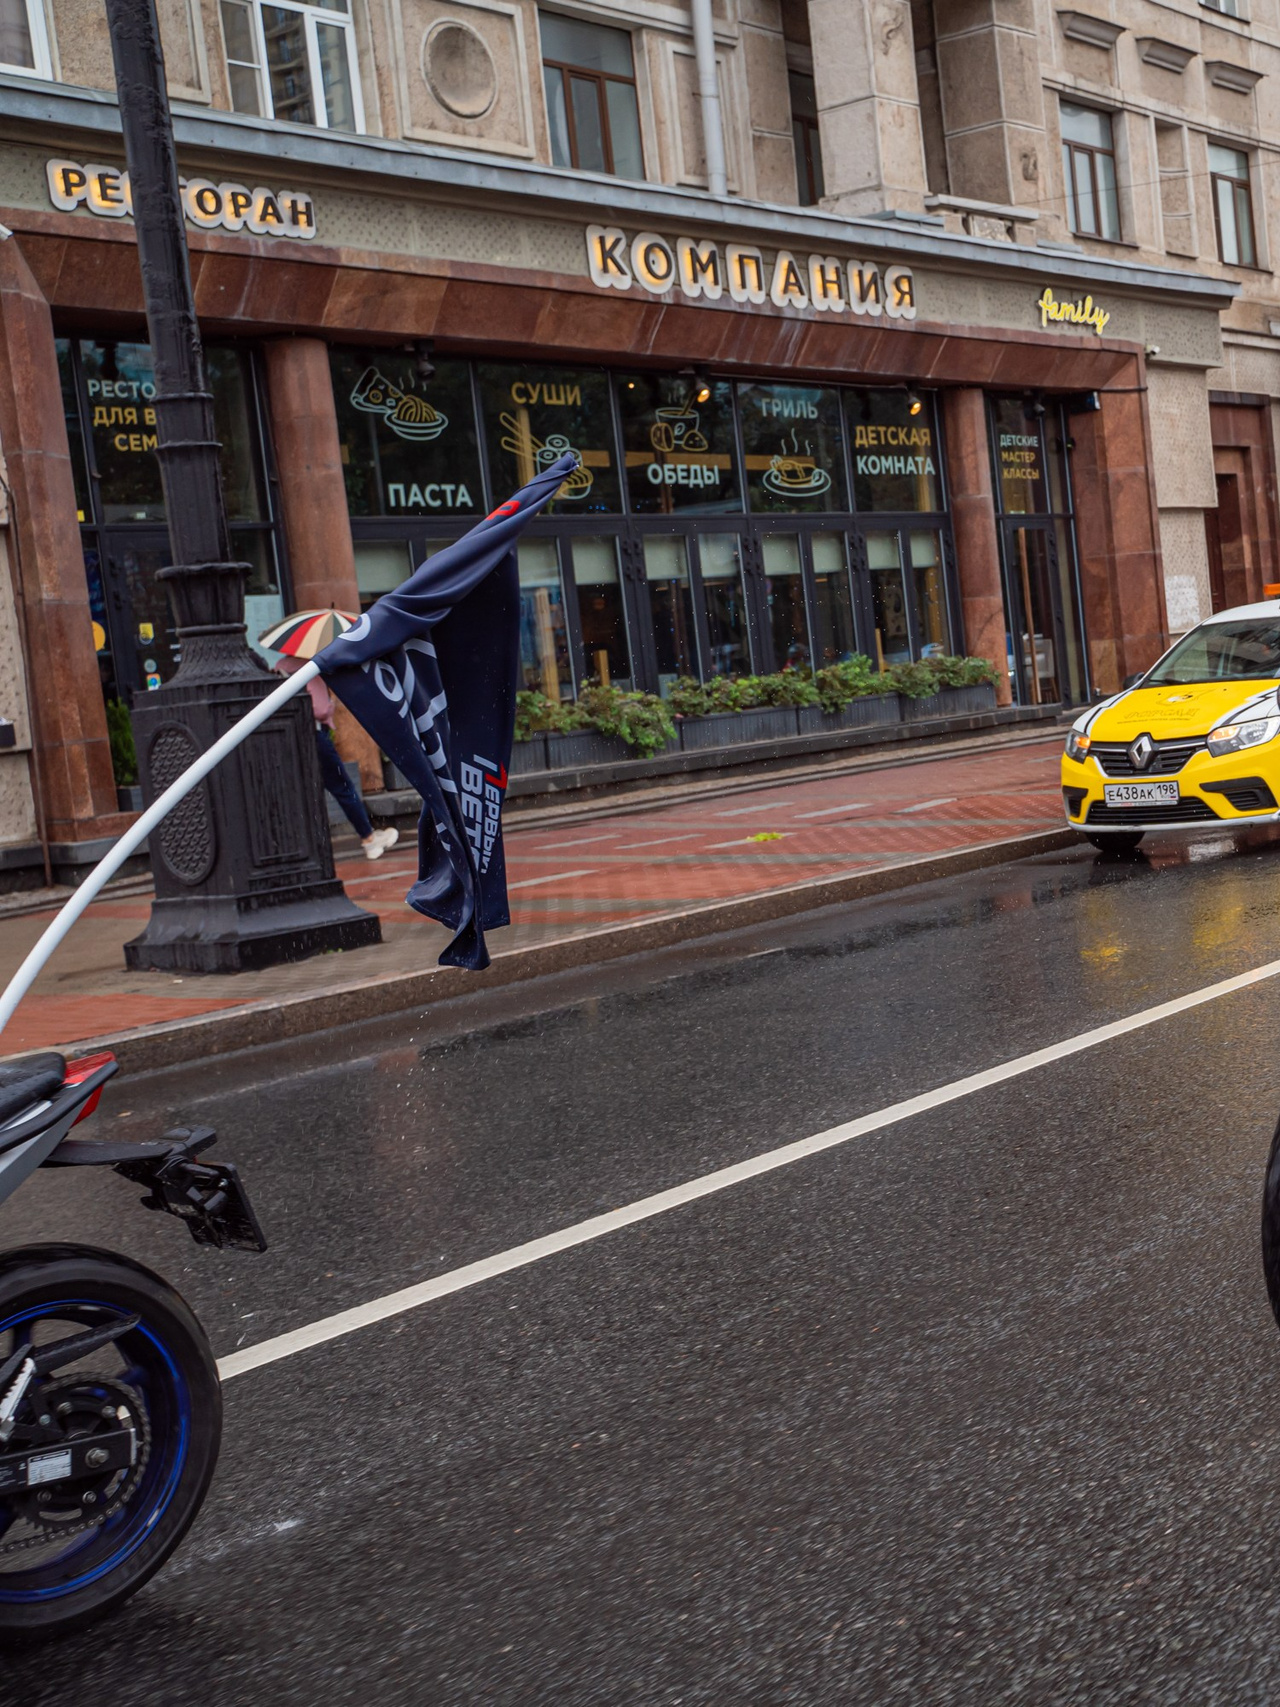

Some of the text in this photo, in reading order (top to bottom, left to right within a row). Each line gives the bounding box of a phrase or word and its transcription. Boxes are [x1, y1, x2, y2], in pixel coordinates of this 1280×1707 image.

[61, 167, 314, 228] РЕОРАН
[599, 235, 914, 309] КОМПАНИЯ
[1038, 287, 1110, 335] family
[87, 379, 156, 399] РЕСТО
[510, 381, 582, 406] СУШИ
[93, 406, 138, 427] ДЛЯ
[761, 398, 819, 420] ГРИЛЬ
[855, 425, 932, 448] ДЕТСКАЯ
[1000, 434, 1039, 448] ДЕТСКИЕ
[856, 455, 936, 476] КОМНАТА
[1001, 451, 1036, 464] МАСТЕР
[647, 463, 720, 488] ОБЕДЫ
[1003, 467, 1040, 480] КЛАССЫ
[388, 483, 474, 508] ПАСТА
[1108, 784, 1175, 801] Е438АК 198
